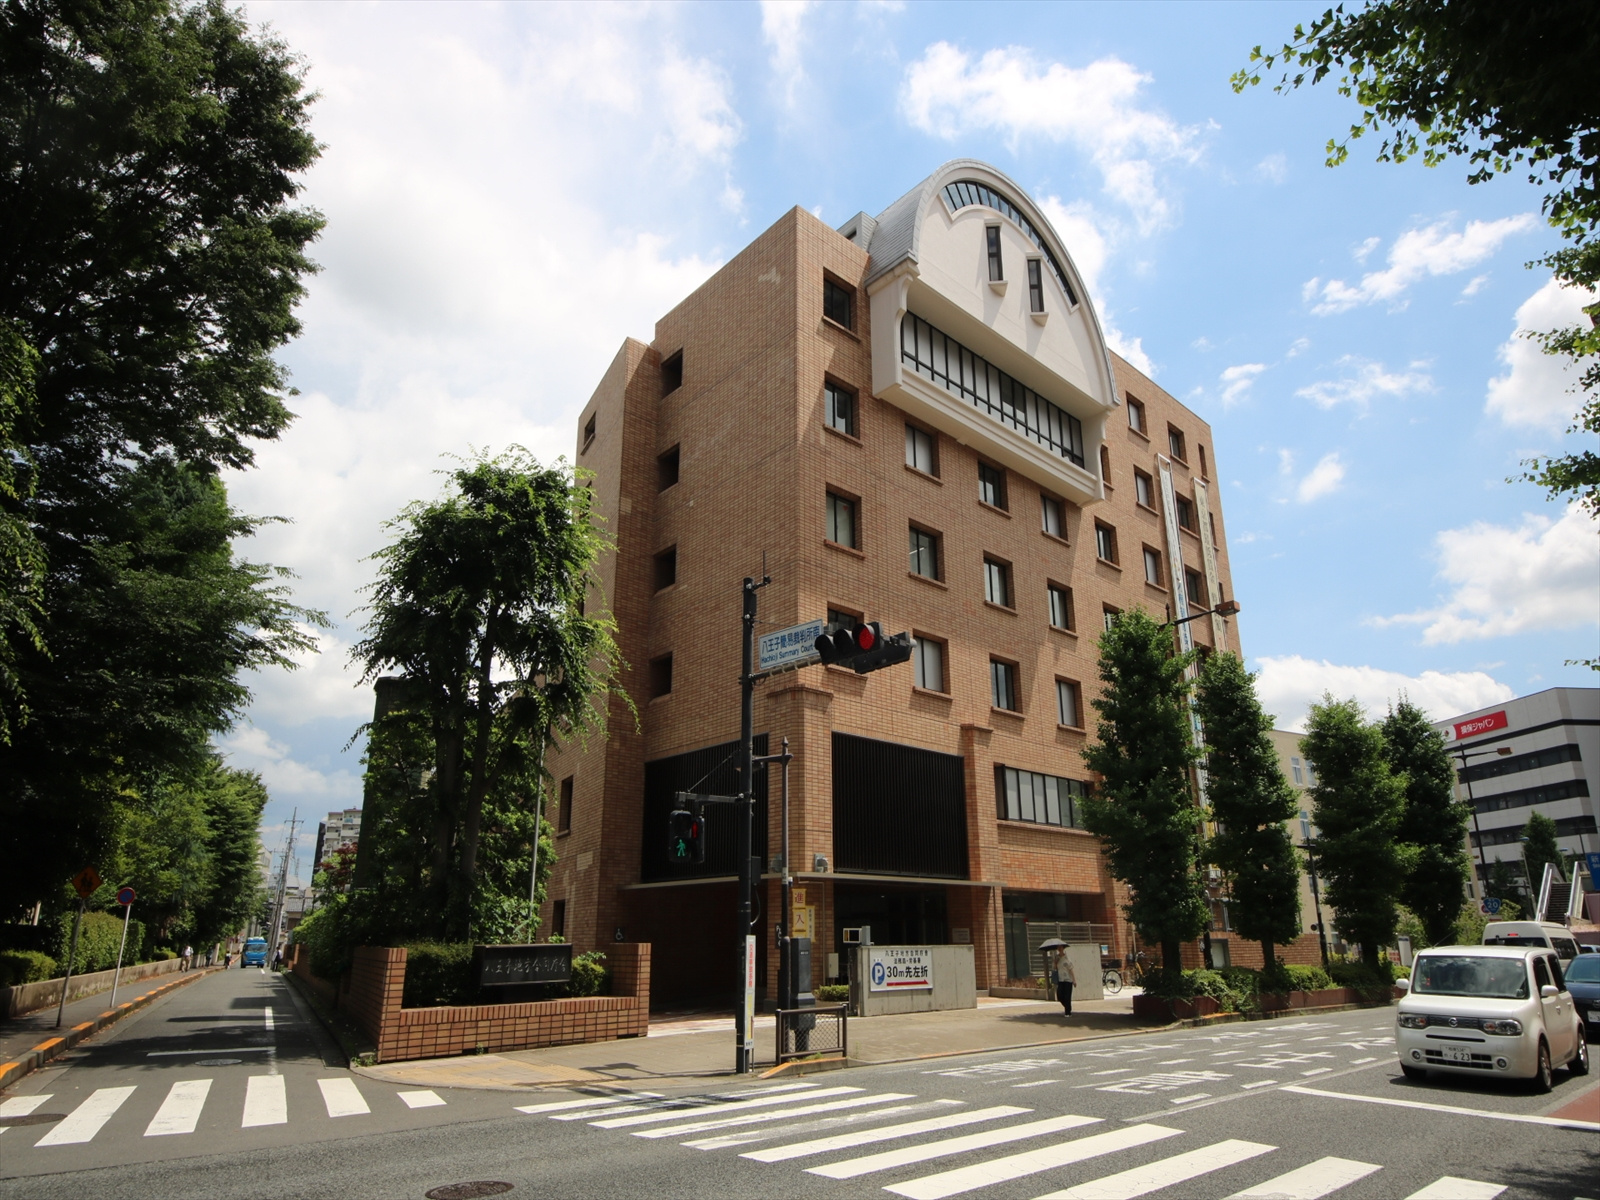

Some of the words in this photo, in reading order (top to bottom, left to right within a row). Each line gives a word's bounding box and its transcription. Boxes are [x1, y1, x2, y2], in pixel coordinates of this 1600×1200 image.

[761, 654, 778, 664] Hachioji
[779, 648, 800, 659] Summary
[801, 643, 814, 653] Court
[1461, 718, 1494, 735] 損保ジャパン
[1486, 901, 1499, 909] 20
[886, 965, 929, 978] 30m先左折
